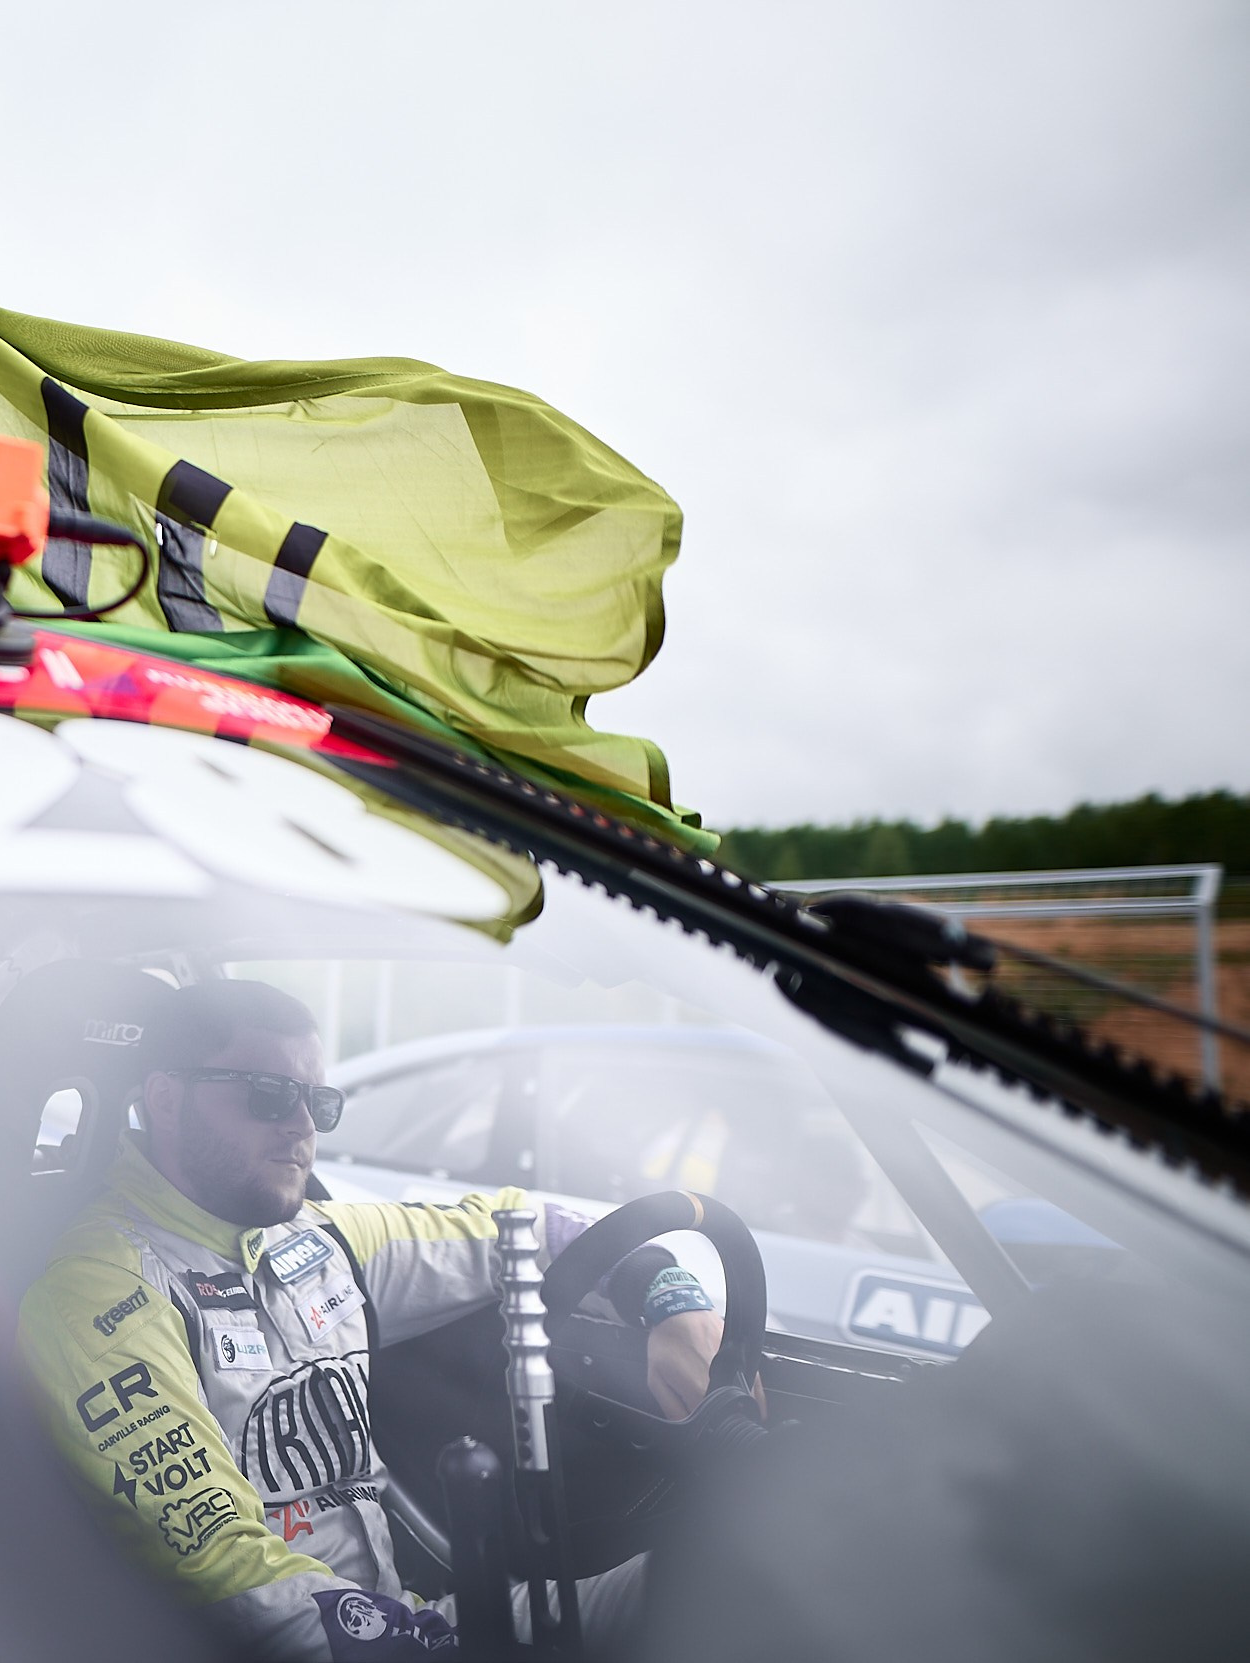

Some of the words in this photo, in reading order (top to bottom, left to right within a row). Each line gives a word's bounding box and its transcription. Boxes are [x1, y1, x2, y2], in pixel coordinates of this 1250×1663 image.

[93, 1289, 149, 1336] freem
[76, 1362, 159, 1433] CR
[98, 1422, 138, 1452] CARVILLE
[136, 1405, 171, 1428] RACING
[129, 1421, 196, 1476] START
[142, 1447, 212, 1496] VOLT
[172, 1491, 232, 1540] VRC
